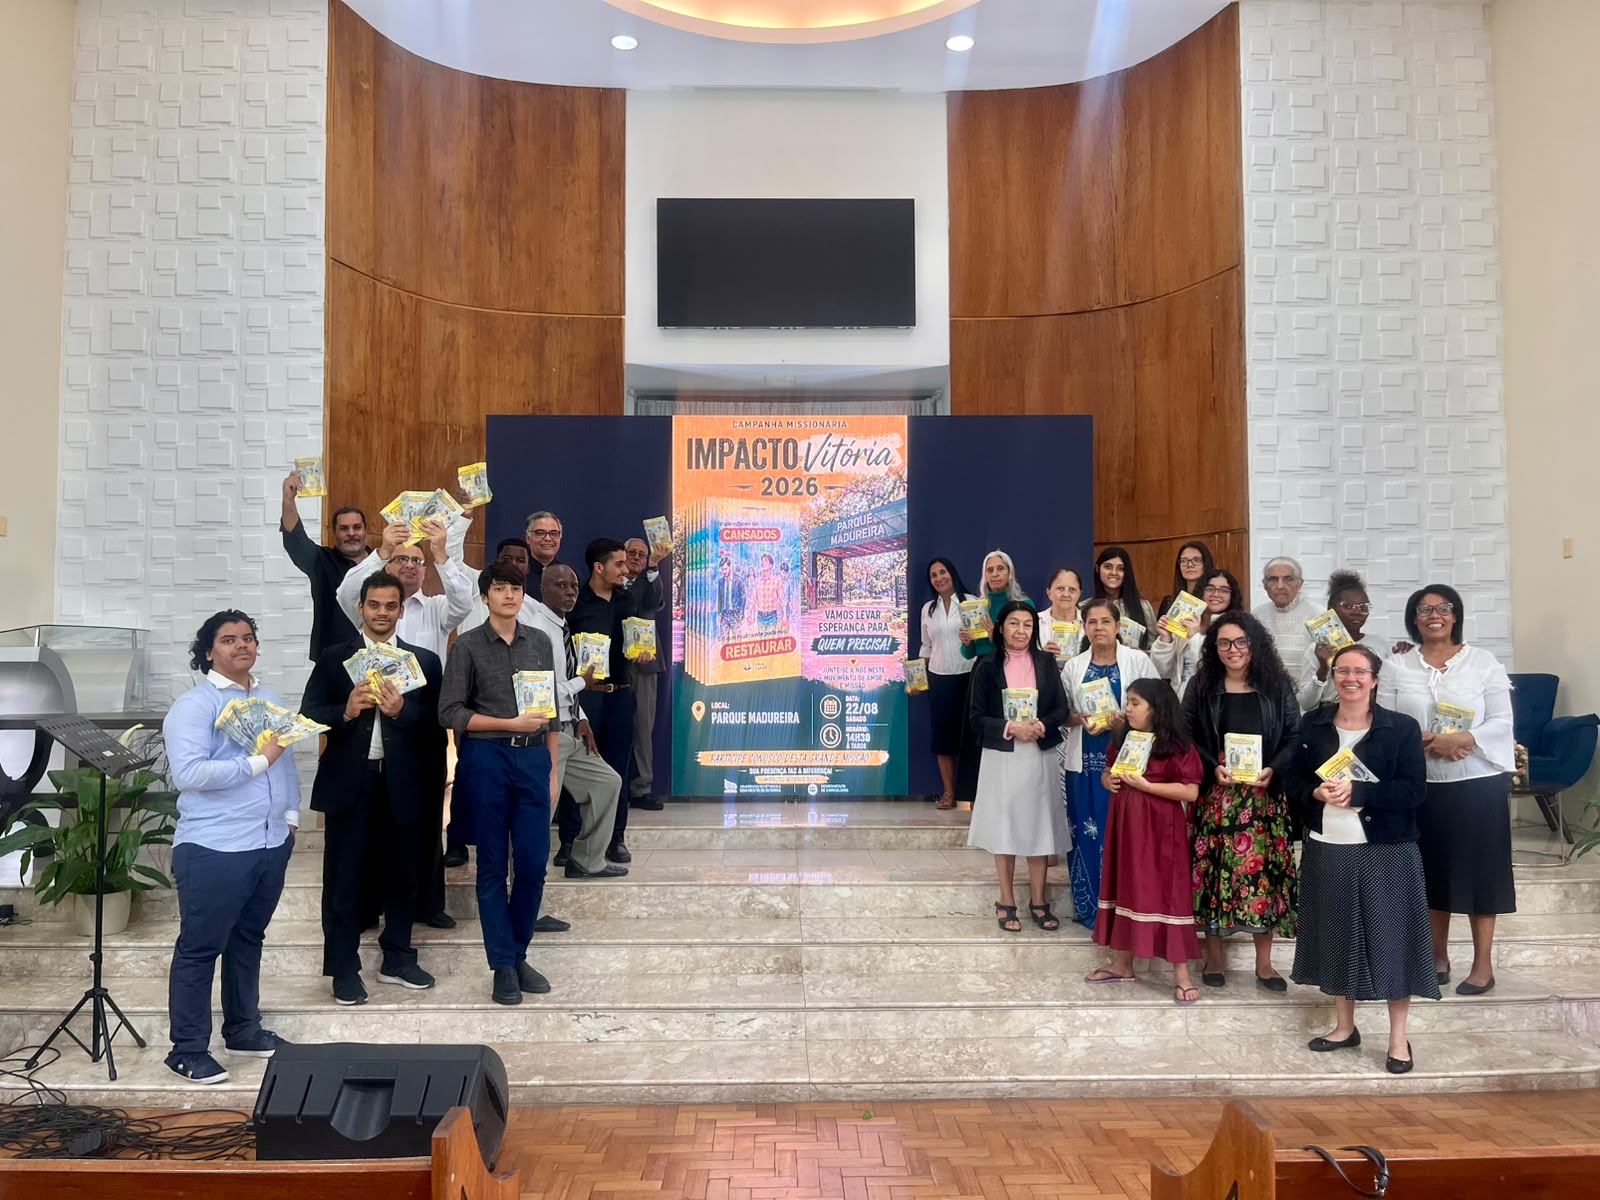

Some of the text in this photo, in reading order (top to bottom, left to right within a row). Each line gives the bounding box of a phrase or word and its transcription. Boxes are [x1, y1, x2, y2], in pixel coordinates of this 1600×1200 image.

[732, 421, 783, 429] CAMPANHA
[686, 433, 894, 473] IMPACTO Vitória
[760, 476, 819, 497] 2026
[836, 513, 875, 532] PARQUE
[723, 529, 777, 540] CANSADOS
[830, 524, 886, 546] MADUREIRA
[825, 610, 881, 620] VAMOS LEVAR
[818, 622, 889, 634] ESPERANÇA PARA
[725, 638, 793, 659] RESTAURAR
[817, 636, 892, 651] QUEM PRECISA!
[710, 701, 730, 709] LOCAL:
[845, 702, 879, 715] 22/08
[711, 711, 800, 724] PARQUE MADUREIRA
[845, 732, 871, 743] 14H30
[711, 754, 747, 764] PARTICIPE
[749, 753, 783, 764] CONOSCO
[784, 753, 807, 764] DESTA
[810, 753, 839, 764] GRANDE
[760, 767, 787, 776] PRESENÇA
